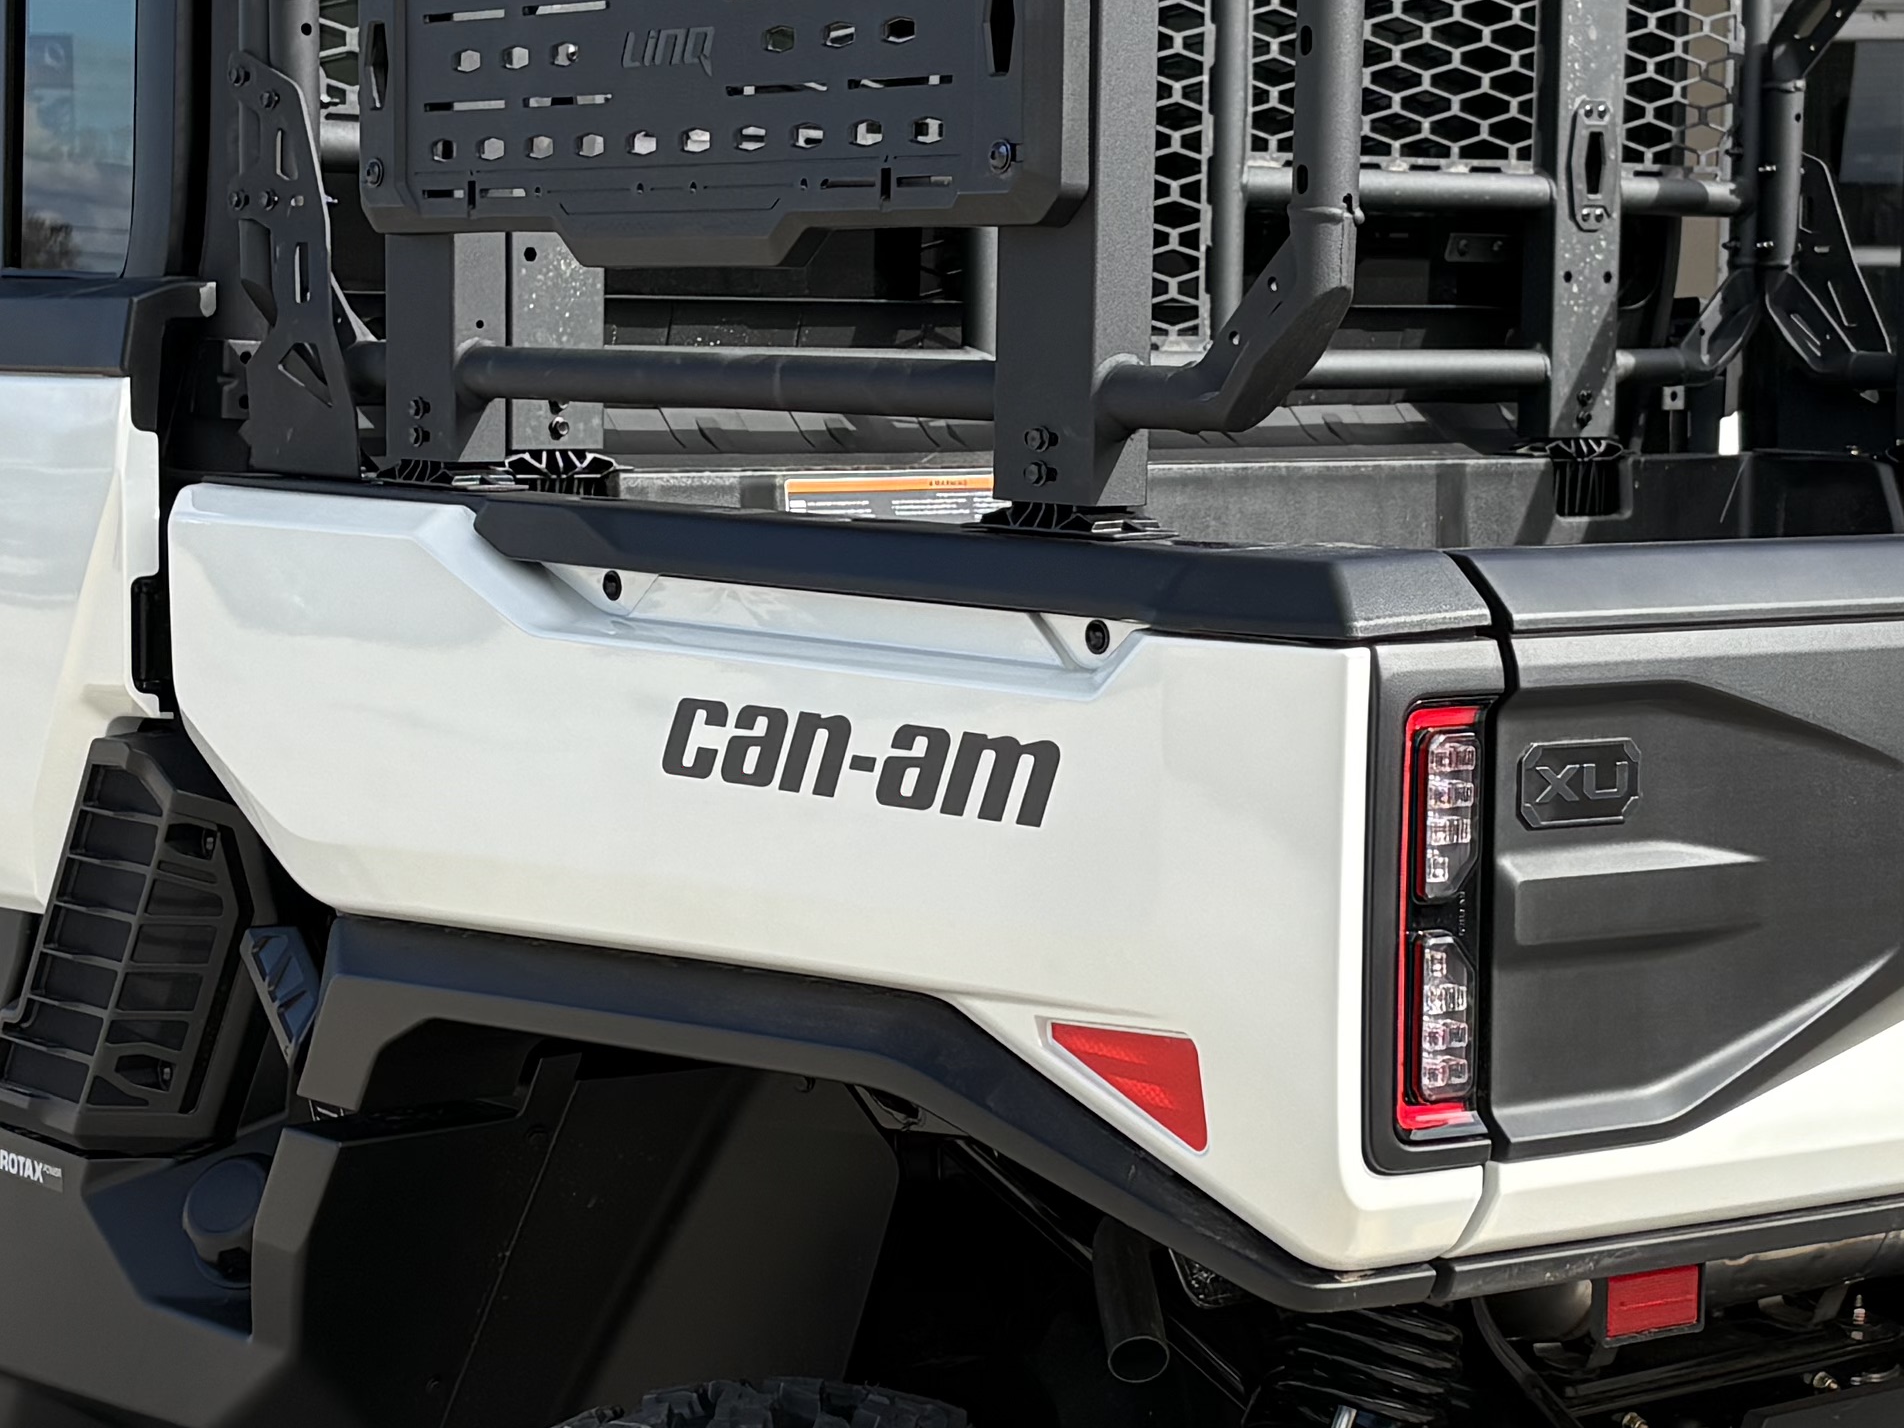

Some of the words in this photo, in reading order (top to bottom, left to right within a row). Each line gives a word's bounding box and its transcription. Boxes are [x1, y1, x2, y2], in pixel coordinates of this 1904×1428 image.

[662, 696, 1062, 828] can-am
[1535, 761, 1630, 804] XU
[0, 1148, 44, 1184] ROTAX
